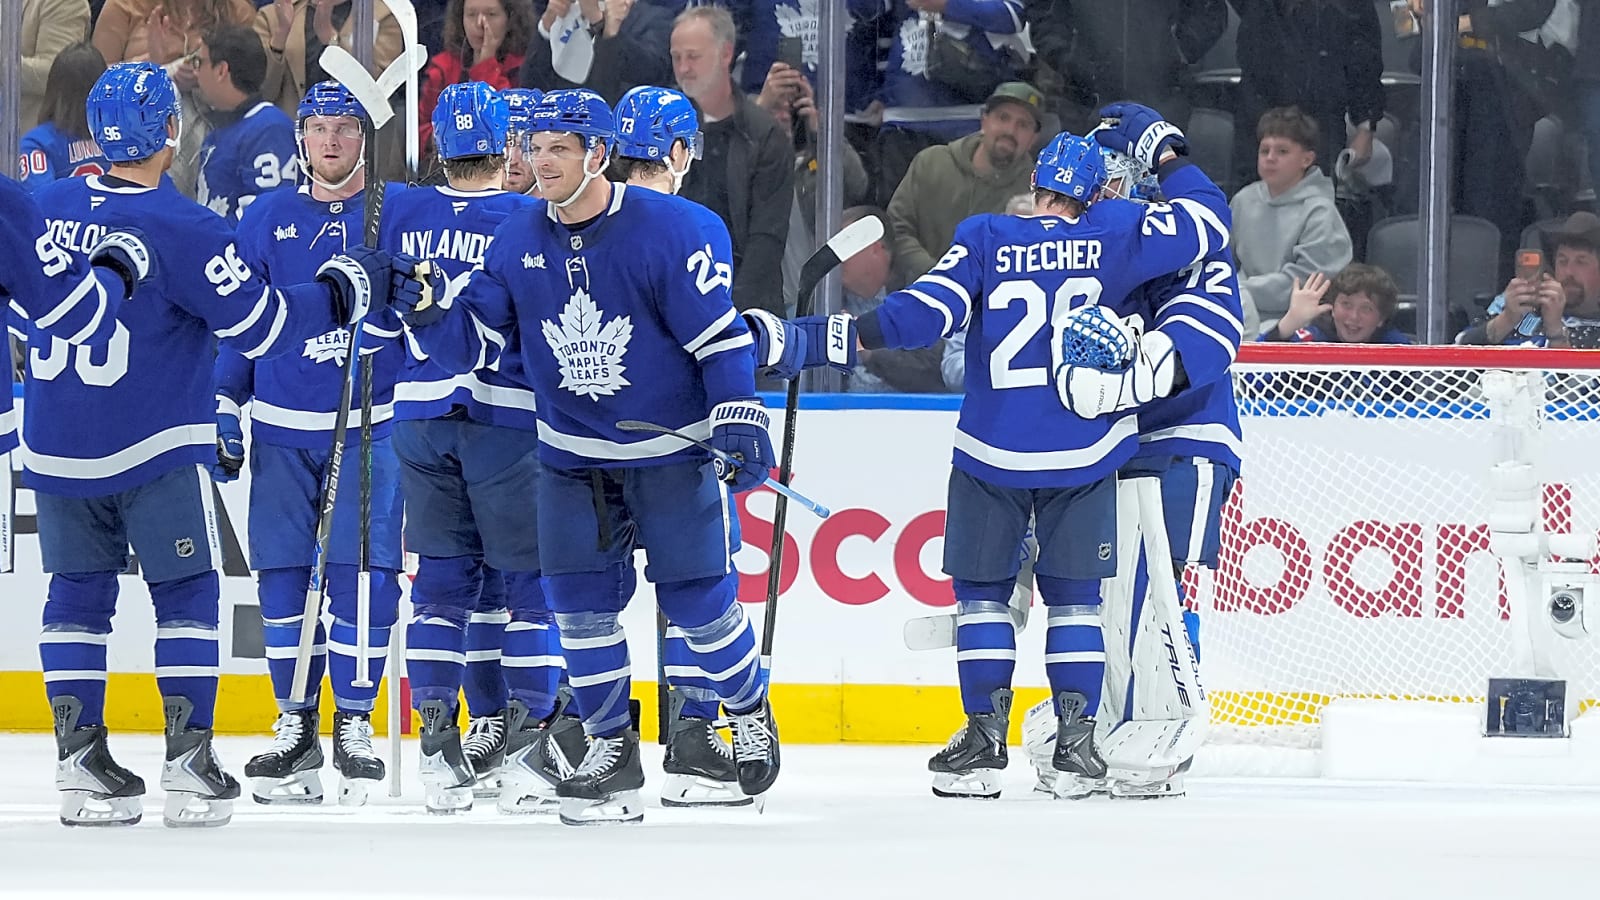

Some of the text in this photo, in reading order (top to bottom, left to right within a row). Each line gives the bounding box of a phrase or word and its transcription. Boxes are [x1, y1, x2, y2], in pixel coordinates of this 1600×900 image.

[455, 114, 474, 130] 88
[621, 117, 635, 134] 73
[103, 126, 122, 141] 96
[253, 152, 297, 189] 34
[1054, 167, 1074, 185] 28
[400, 228, 495, 266] NYLAND
[995, 239, 1103, 274] STECHER
[204, 242, 251, 296] 96
[1179, 260, 1233, 297] 72
[316, 332, 350, 345] LEAF
[558, 340, 617, 359] TORONTO
[567, 356, 609, 369] MAPLE
[569, 367, 611, 380] LEAFS
[714, 405, 771, 430] WARRI
[327, 441, 344, 502] BAUER
[1160, 622, 1192, 709] TRUE
